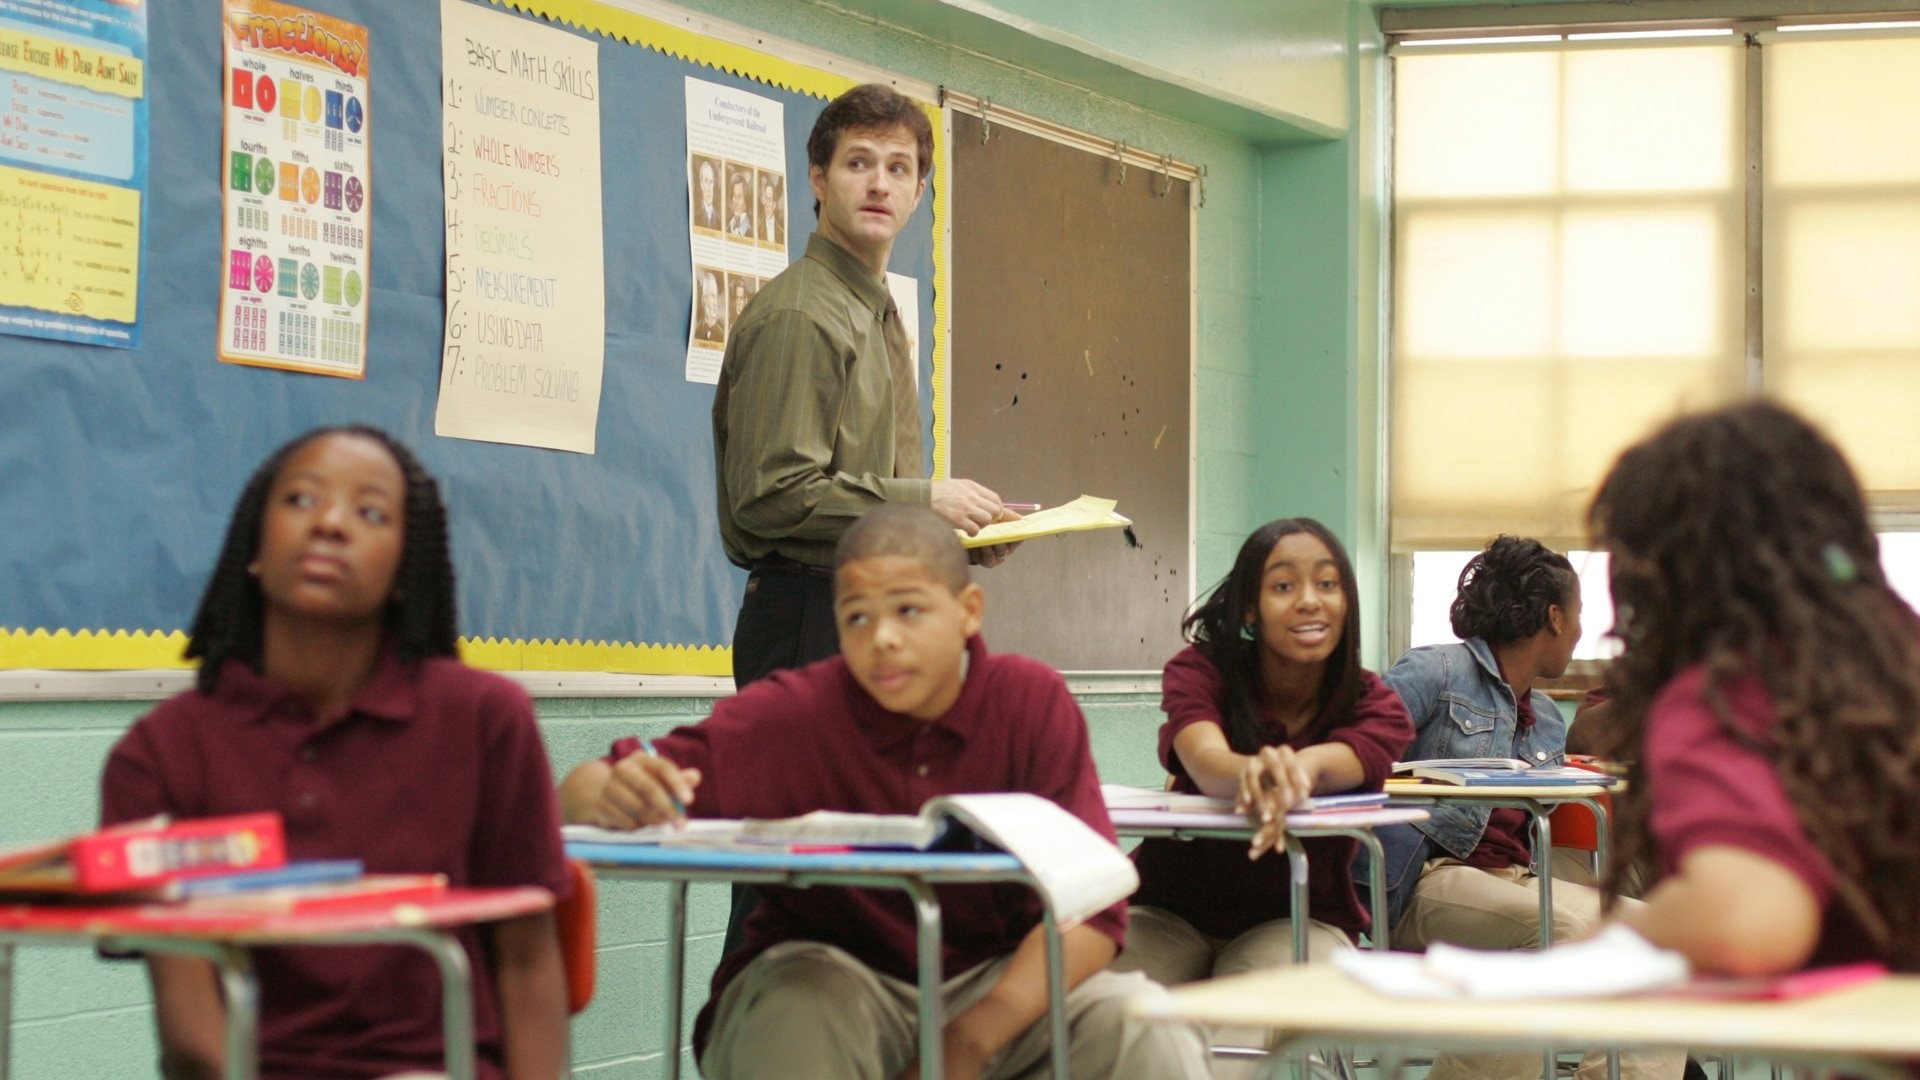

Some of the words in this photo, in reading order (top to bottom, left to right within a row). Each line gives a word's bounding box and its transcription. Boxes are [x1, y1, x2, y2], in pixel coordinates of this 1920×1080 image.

[0, 42, 19, 59] EASE
[73, 50, 93, 76] DEAR
[96, 56, 116, 82] AUNT
[118, 62, 138, 86] SALLY
[242, 58, 267, 72] whole
[465, 38, 507, 74] BASIC
[511, 49, 548, 85] MATH
[289, 67, 314, 83] halves
[335, 79, 354, 94] thirds
[475, 87, 518, 122] NUMBER
[240, 140, 267, 155] fourths
[291, 150, 309, 164] fifths
[473, 134, 511, 167] WHOLE
[514, 144, 560, 178] NUMBERS
[334, 160, 354, 173] sixths
[239, 235, 268, 250] eighths
[288, 243, 311, 257] tenths
[329, 251, 356, 265] twelfths
[476, 267, 557, 309] MEASUREMENT
[515, 319, 544, 353] DATA
[474, 354, 527, 395] PROBLEM
